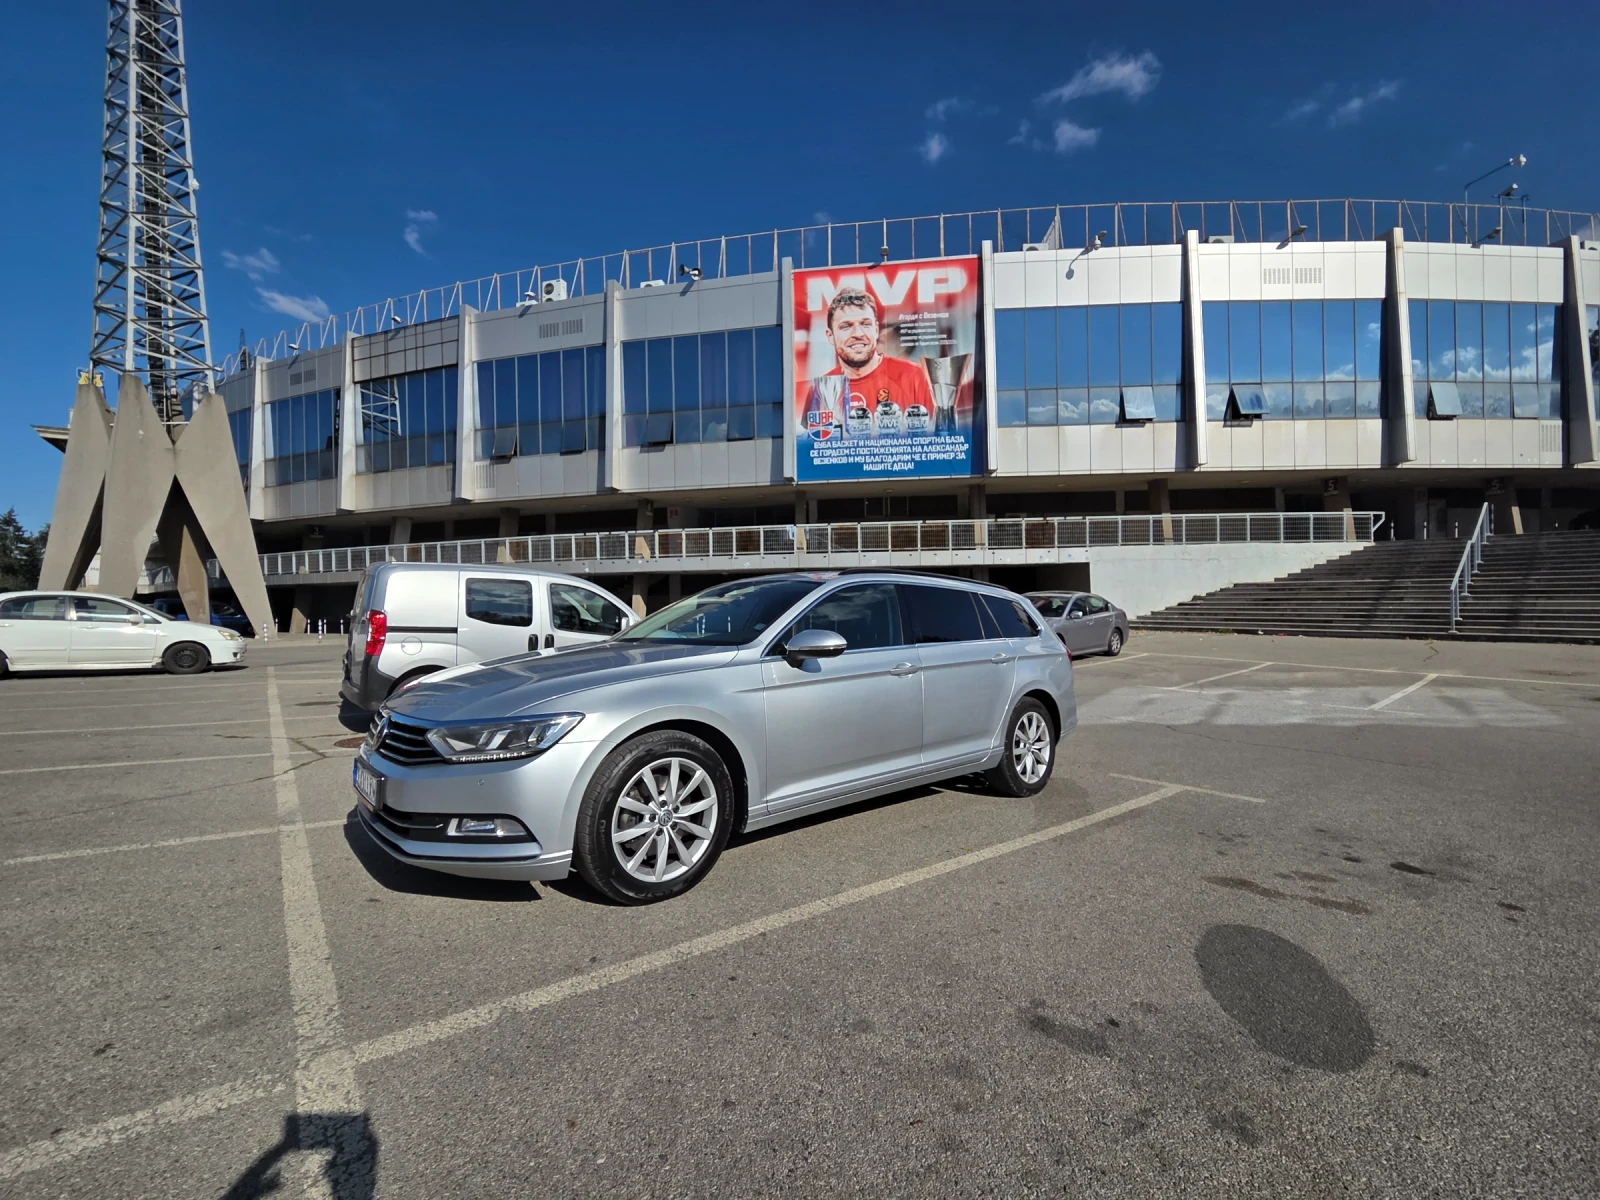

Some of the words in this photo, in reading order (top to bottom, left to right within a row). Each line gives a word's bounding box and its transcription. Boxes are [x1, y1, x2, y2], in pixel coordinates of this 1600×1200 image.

[807, 267, 968, 311] MVP
[814, 441, 831, 449] БУБА
[832, 440, 858, 448] БАСКЕТ
[865, 438, 912, 447] НАЦИОНАЛНА
[913, 436, 945, 444] СПОРТНА
[946, 435, 965, 443] БАЗА
[820, 448, 850, 457] ГОРДЕЕМ
[856, 446, 912, 455] ПОСТИЖЕНИЯТА
[913, 445, 922, 453] НА
[923, 443, 969, 452] АЛЕКСАНДЪР
[813, 457, 847, 465] ВЕЗЕНКОВ
[865, 454, 911, 463] БЛАГОДАРИМ
[912, 453, 921, 461] ЧЕ
[922, 453, 927, 461] Е
[927, 452, 955, 461] ПРИМЕР
[956, 452, 966, 460] ЗА
[863, 463, 892, 471] НАШИТЕ
[893, 462, 914, 471] ДЕЦА!
[1327, 479, 1336, 490] 5
